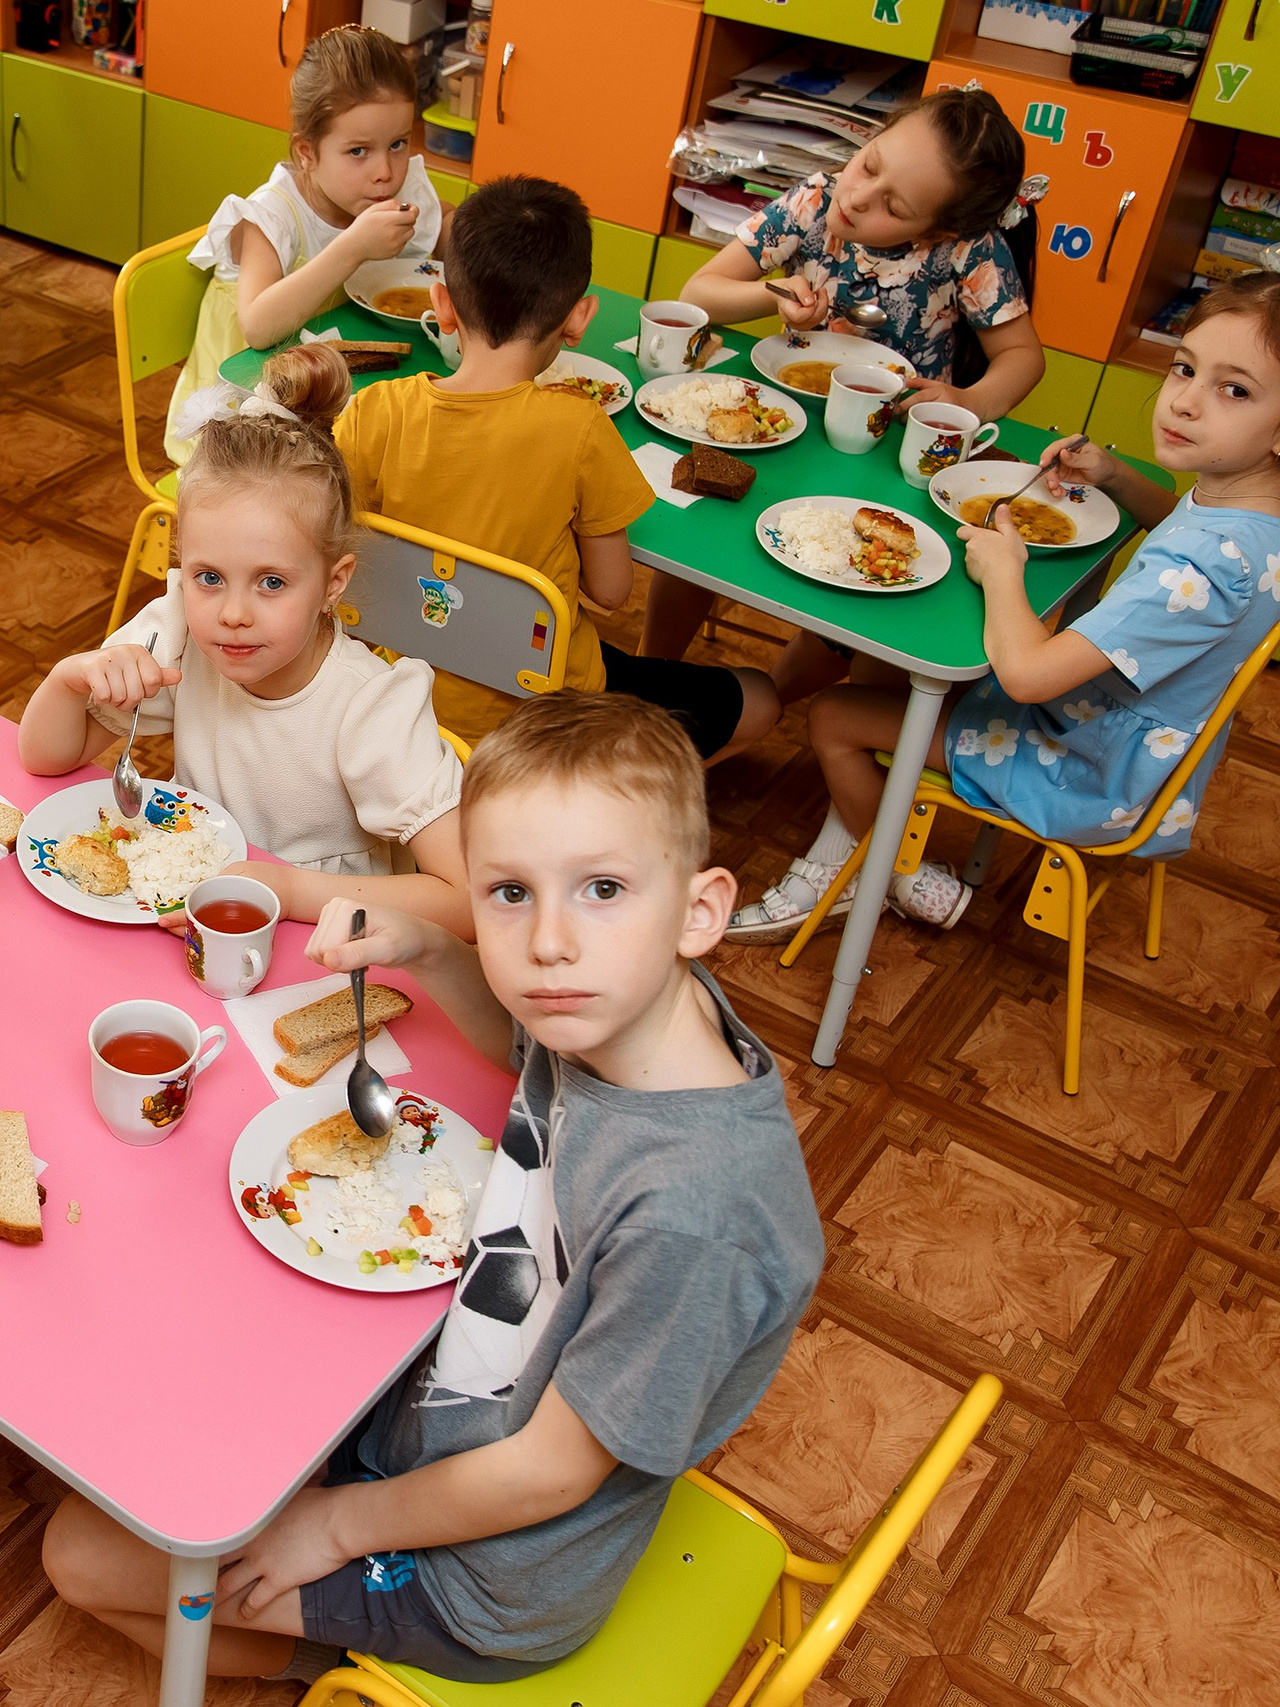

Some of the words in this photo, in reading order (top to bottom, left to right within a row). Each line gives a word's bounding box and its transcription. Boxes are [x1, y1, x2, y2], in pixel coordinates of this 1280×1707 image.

[1023, 103, 1067, 144] Щ
[1083, 131, 1113, 168] Ъ
[1049, 224, 1092, 259] Ю
